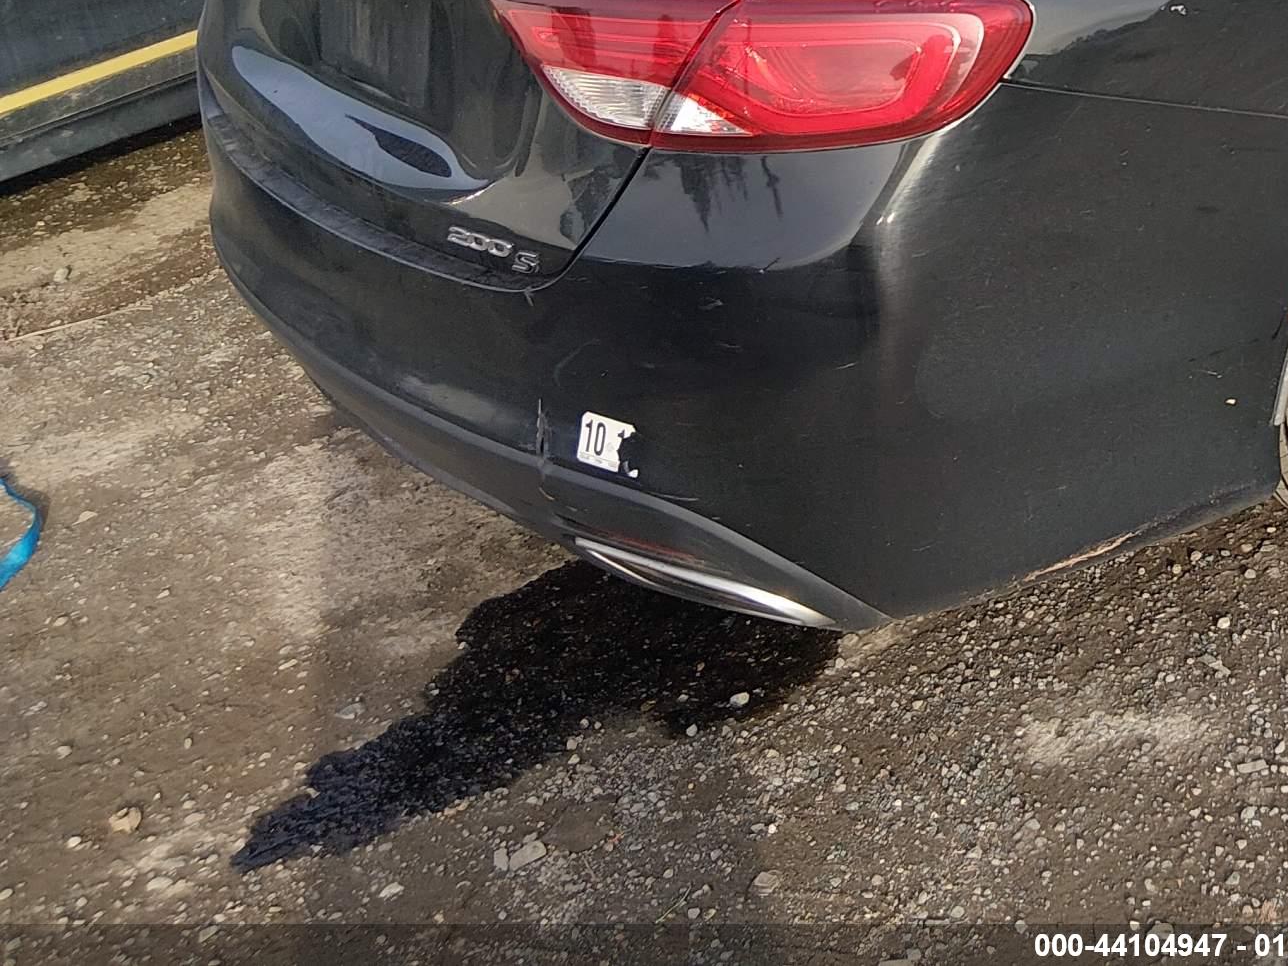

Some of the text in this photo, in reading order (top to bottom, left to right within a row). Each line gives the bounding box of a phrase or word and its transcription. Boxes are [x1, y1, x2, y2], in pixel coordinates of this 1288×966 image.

[447, 226, 540, 274] 200 S
[585, 419, 607, 456] 10
